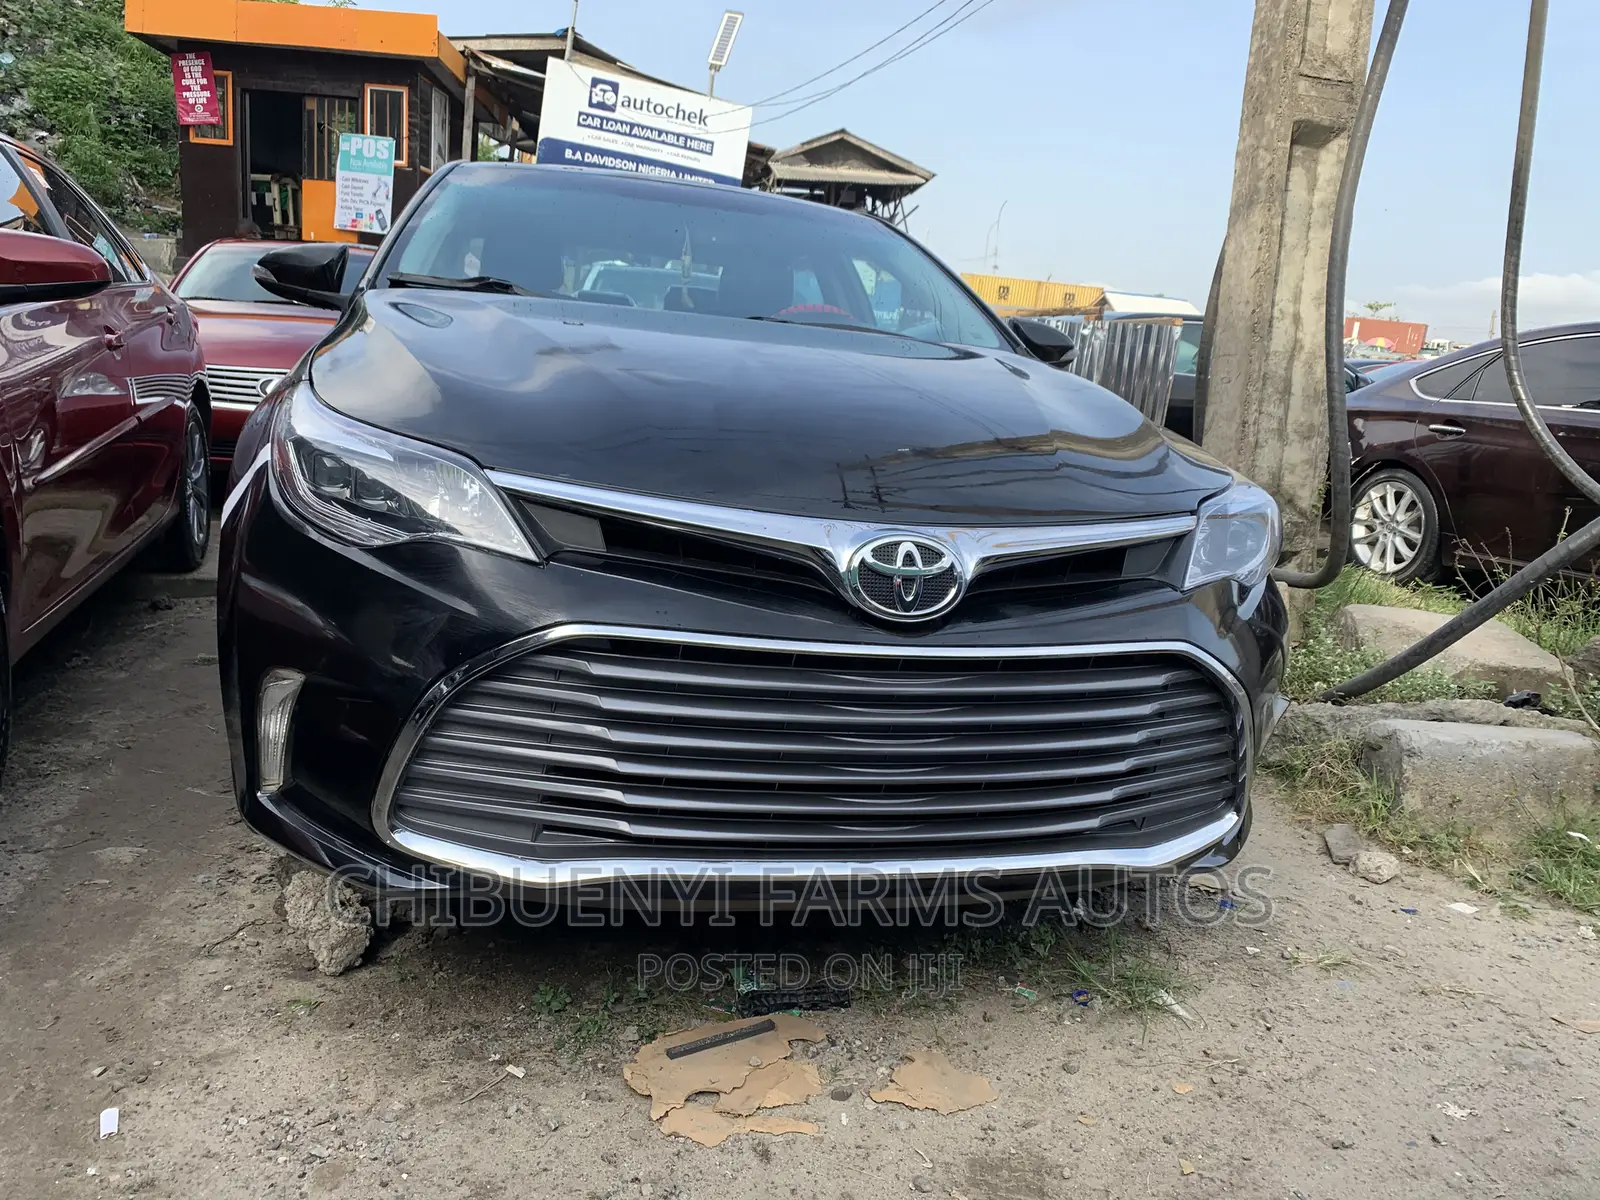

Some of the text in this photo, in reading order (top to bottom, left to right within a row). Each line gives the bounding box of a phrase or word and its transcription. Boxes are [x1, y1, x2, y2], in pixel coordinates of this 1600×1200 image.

[621, 94, 708, 126] autochek
[351, 136, 389, 159] POS
[580, 115, 601, 128] CAR
[603, 120, 630, 134] LOAN
[631, 126, 686, 147] AVAILABLE
[687, 138, 712, 153] HERE
[564, 148, 582, 161] B.A
[584, 152, 636, 171] DAVIDSON
[638, 163, 676, 178] NIGERIA
